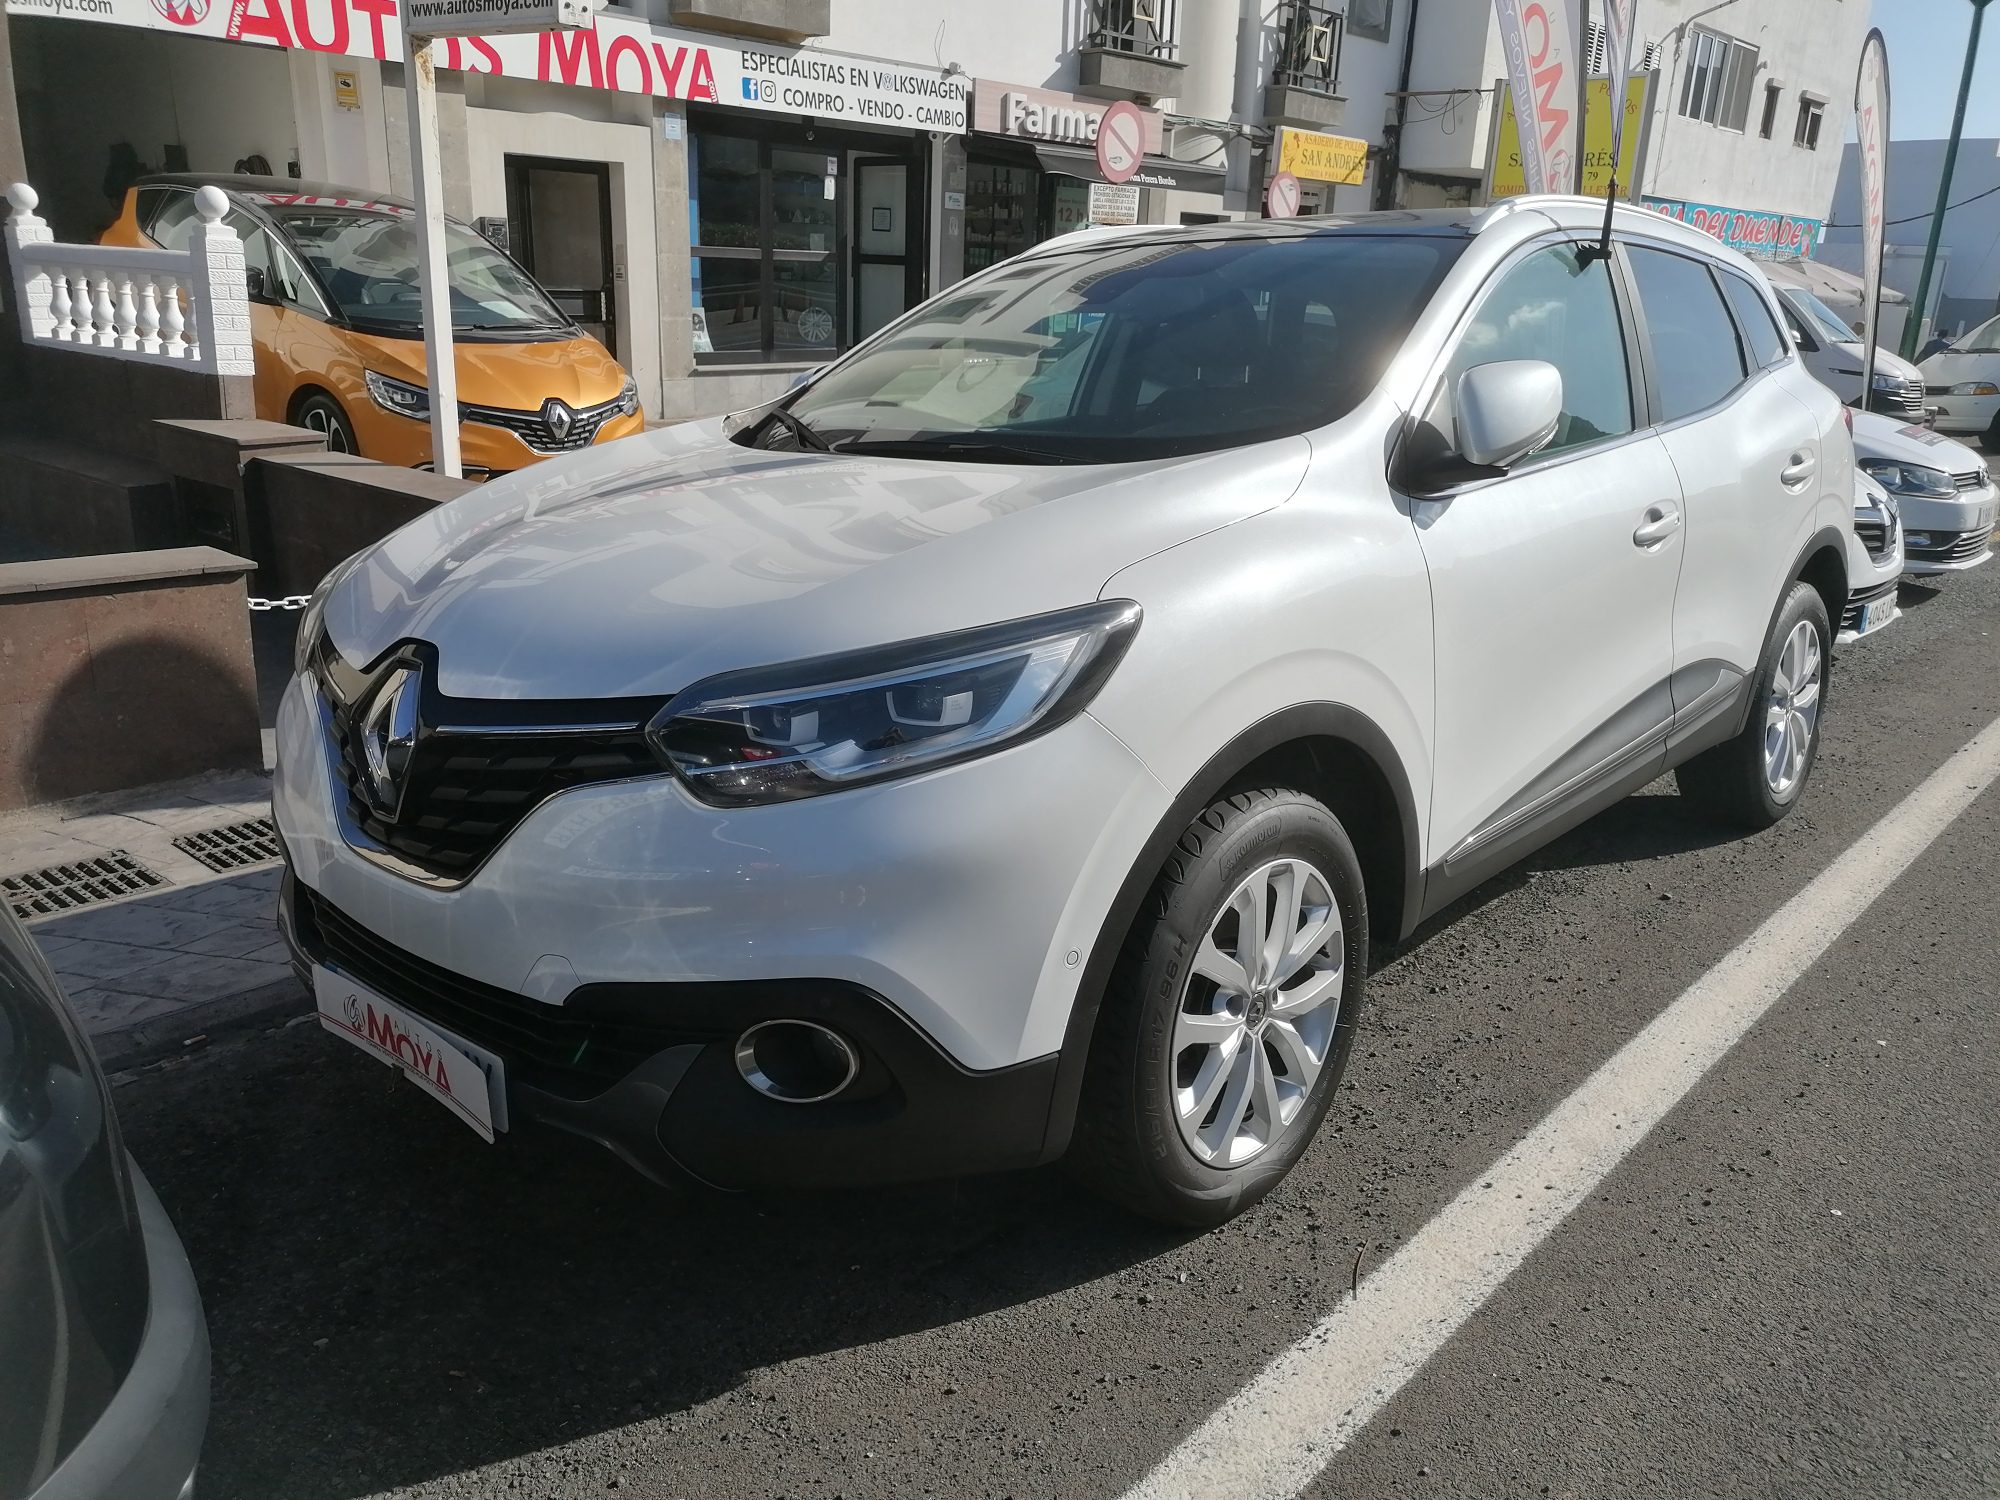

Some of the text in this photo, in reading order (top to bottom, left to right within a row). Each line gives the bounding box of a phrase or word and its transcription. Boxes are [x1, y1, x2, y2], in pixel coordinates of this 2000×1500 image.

[226, 0, 720, 104] AUT MOYA
[741, 50, 845, 84] ESPECIALISTAS
[850, 67, 869, 89] EN
[783, 88, 844, 113] COMPRO
[858, 98, 904, 120] VENDO
[916, 106, 965, 128] CAMBIO
[1003, 92, 1101, 141] Farma
[1301, 148, 1322, 166] SAN
[1584, 148, 1616, 168] RÉS
[1493, 183, 1628, 196] COMID LLEVR
[366, 1003, 452, 1094] MOYA
